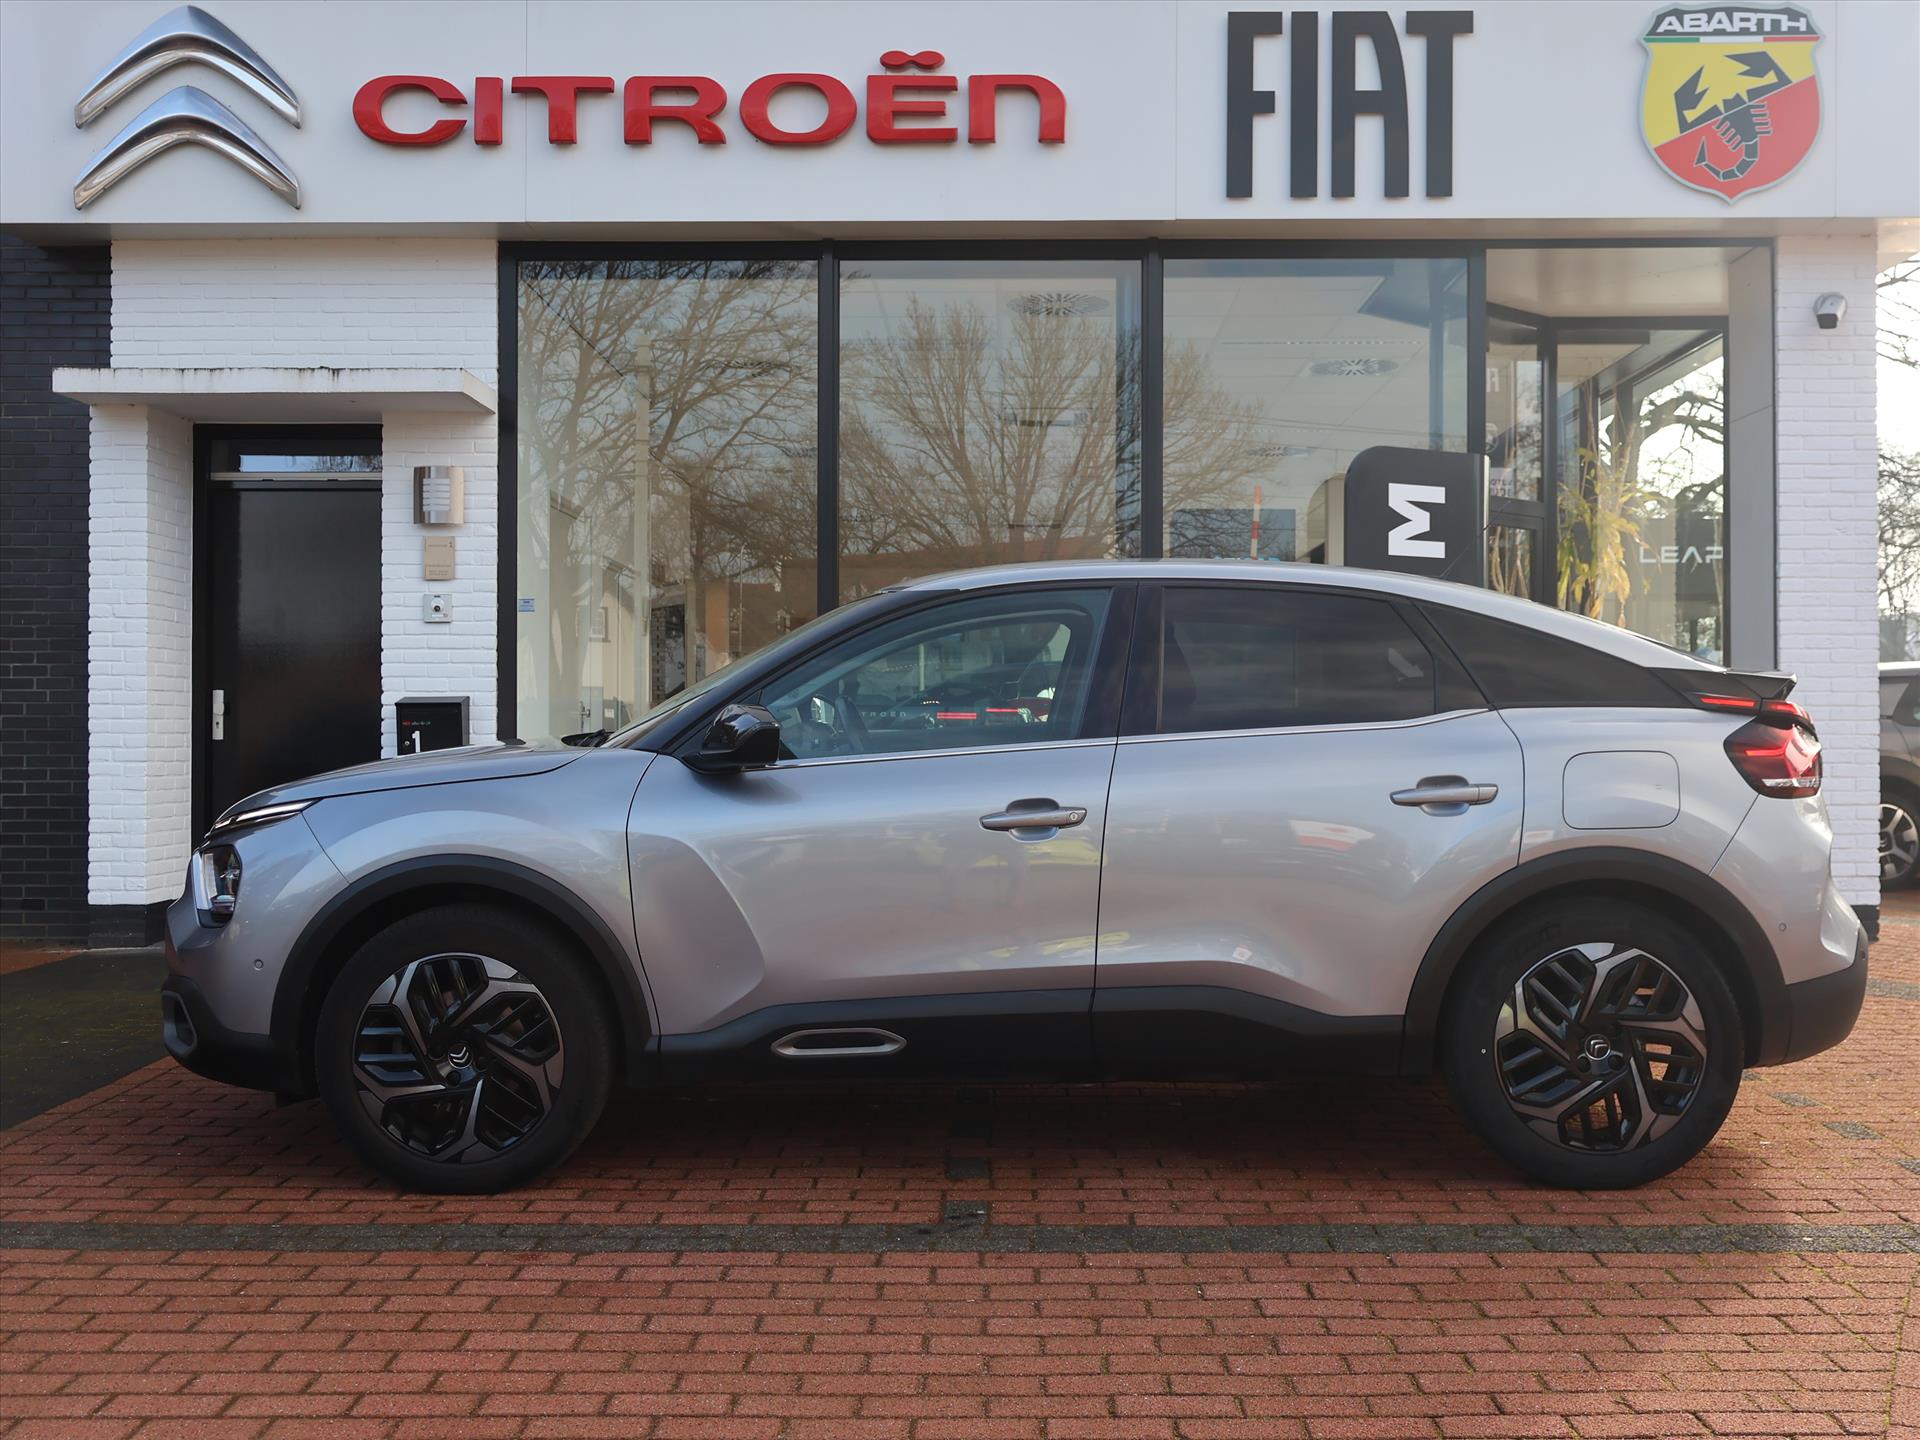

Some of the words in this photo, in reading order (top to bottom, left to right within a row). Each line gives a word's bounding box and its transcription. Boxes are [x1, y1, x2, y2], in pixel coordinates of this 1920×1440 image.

[1656, 11, 1807, 33] ABARTH
[352, 50, 1067, 148] CITROËN
[1226, 10, 1474, 198] FIAT
